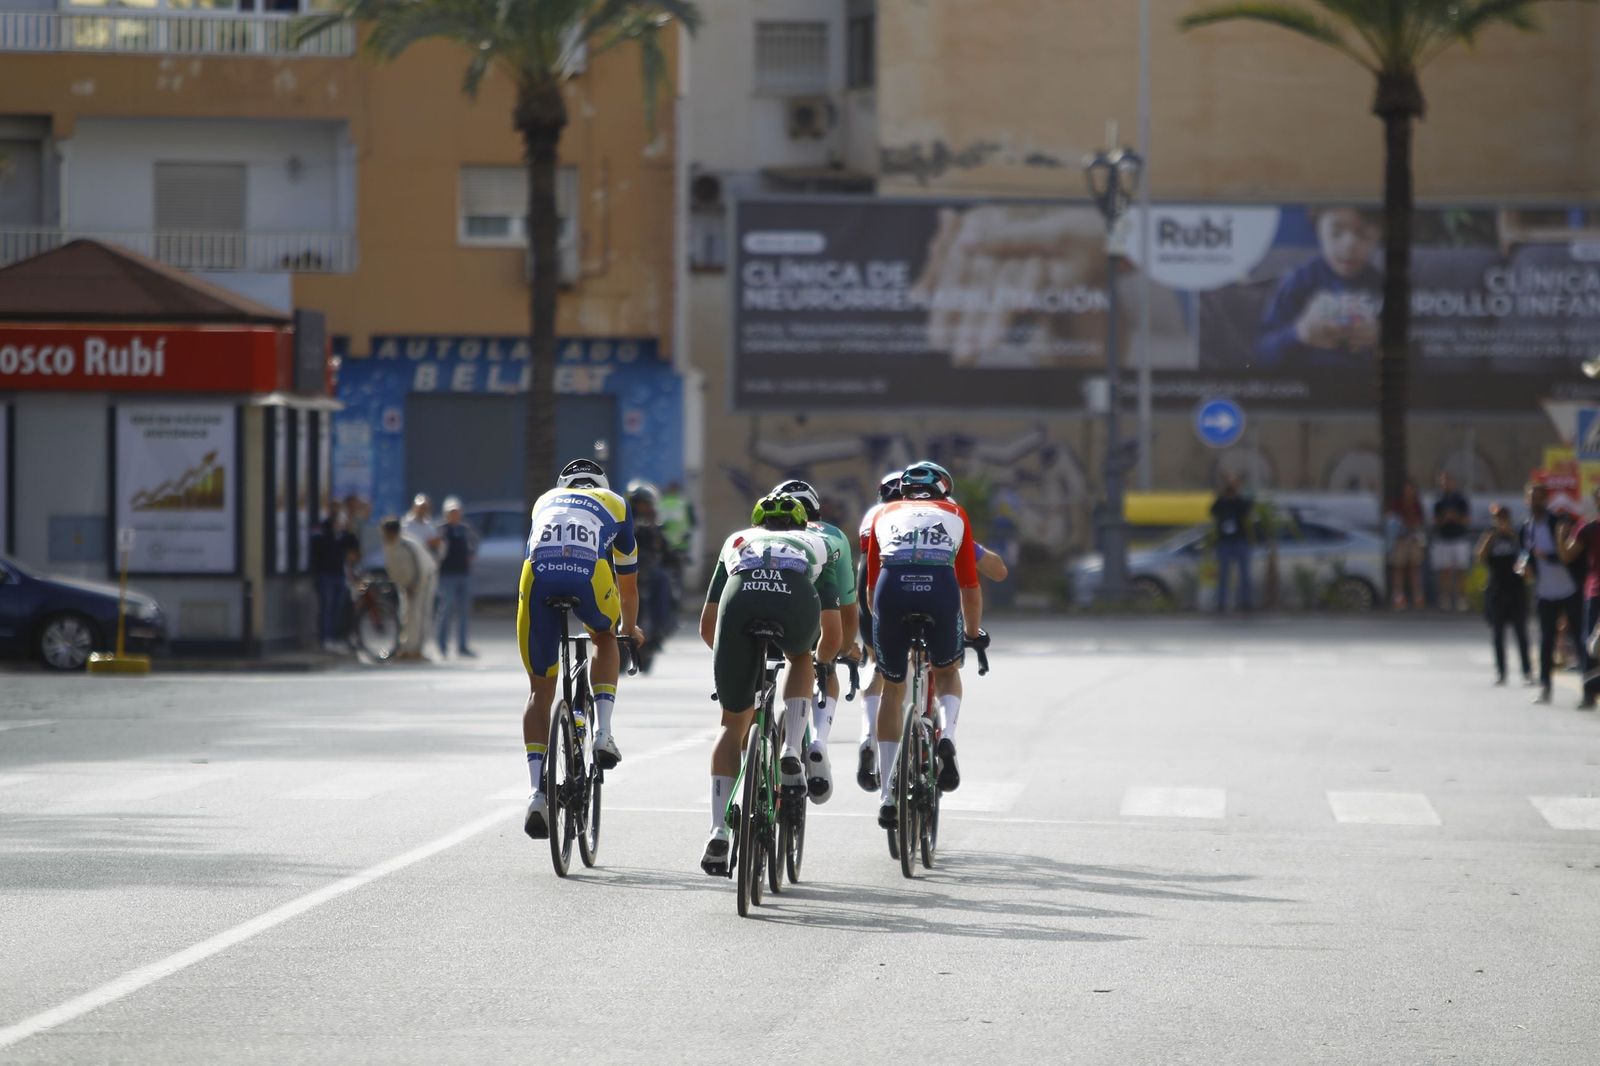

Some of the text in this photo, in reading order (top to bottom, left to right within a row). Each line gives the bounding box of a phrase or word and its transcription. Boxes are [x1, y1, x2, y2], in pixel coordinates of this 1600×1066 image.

[1156, 215, 1233, 248] Rubí
[866, 260, 909, 287] DE
[83, 335, 167, 377] Rubí
[378, 338, 639, 363] AUTOLAADO
[555, 497, 600, 512] baloise
[548, 562, 590, 575] baloise
[751, 569, 783, 581] CAJA
[742, 581, 792, 595] RURAL
